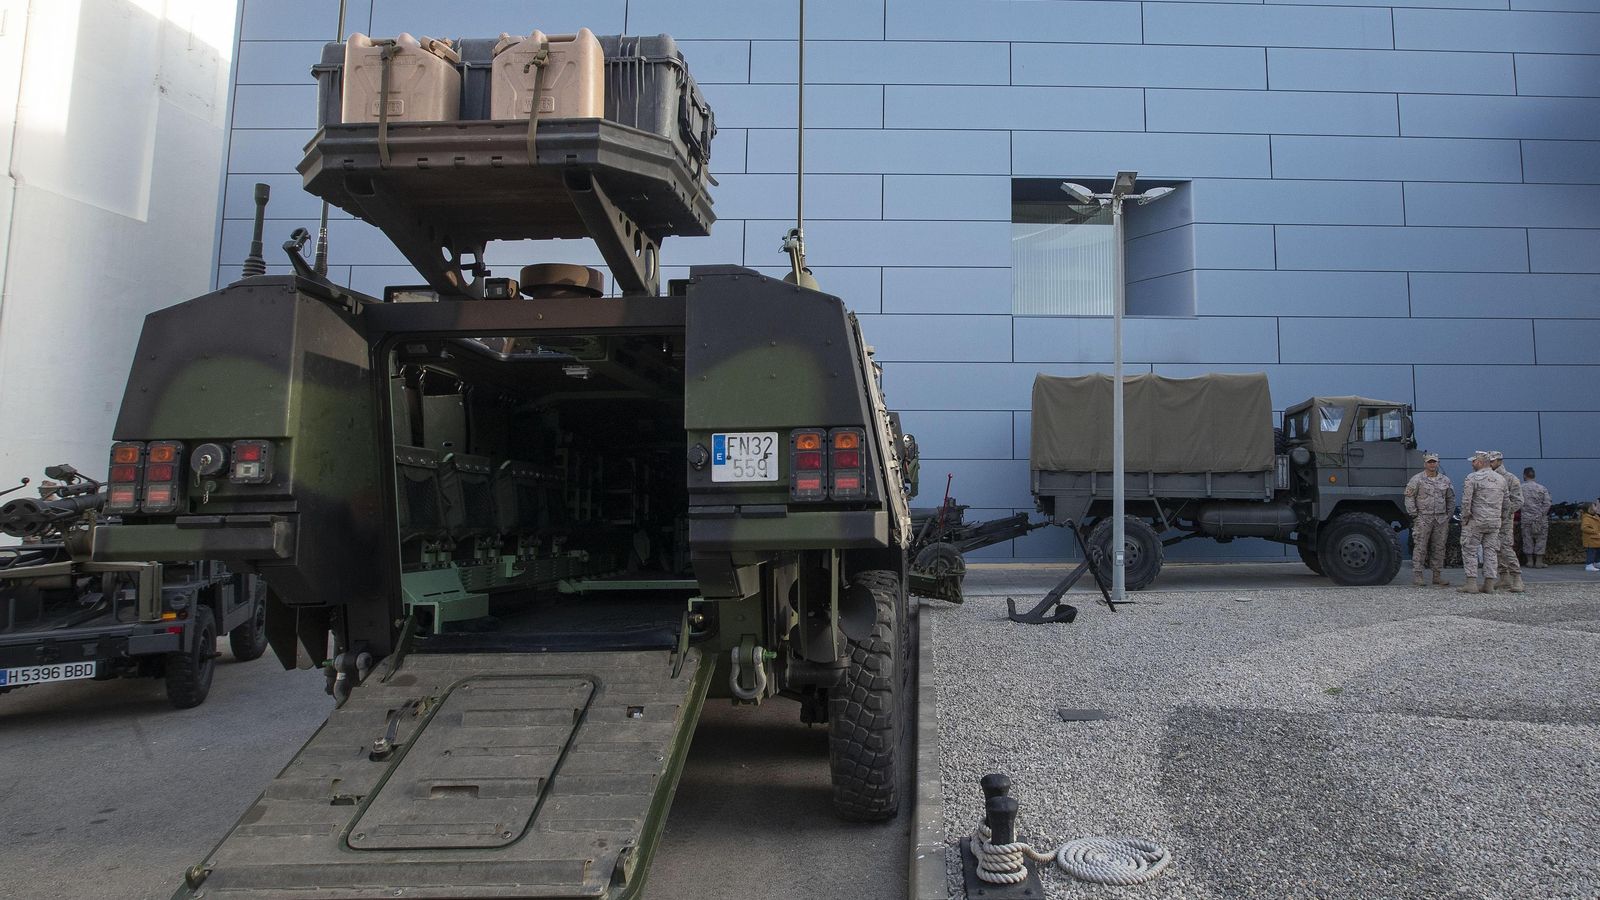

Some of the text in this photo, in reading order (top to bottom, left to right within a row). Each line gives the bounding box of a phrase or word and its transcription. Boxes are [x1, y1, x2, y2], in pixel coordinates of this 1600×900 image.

[727, 436, 773, 456] FN32
[716, 453, 723, 461] E
[734, 458, 768, 478] 559
[8, 663, 93, 683] H 5396 BBD
